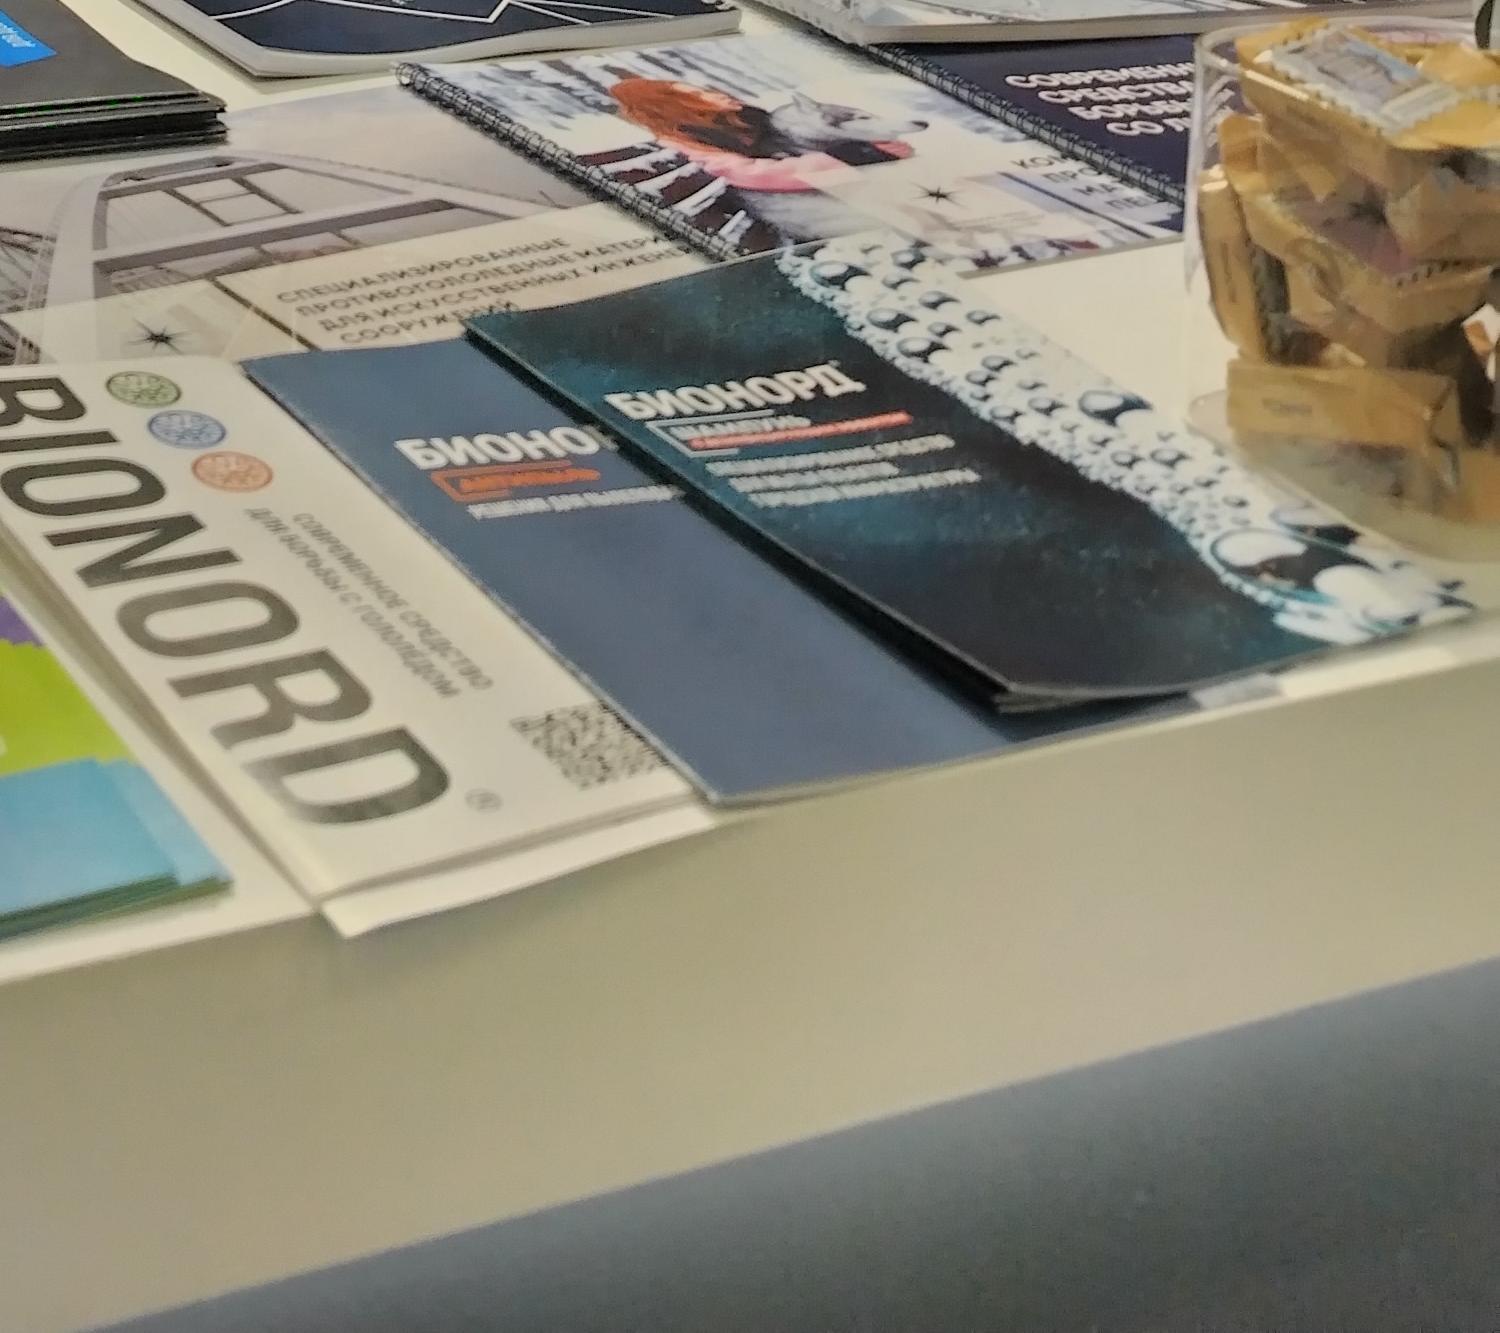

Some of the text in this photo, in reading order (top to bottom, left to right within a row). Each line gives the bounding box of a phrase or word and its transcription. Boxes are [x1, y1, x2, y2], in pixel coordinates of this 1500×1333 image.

[1005, 62, 1195, 88] СОВРЕМЕНН
[276, 236, 570, 304] СПЕЦИАЛИЗИРОВАННЫЕ
[318, 311, 375, 331] ДЛЯ
[603, 363, 868, 422] БИОНОРД
